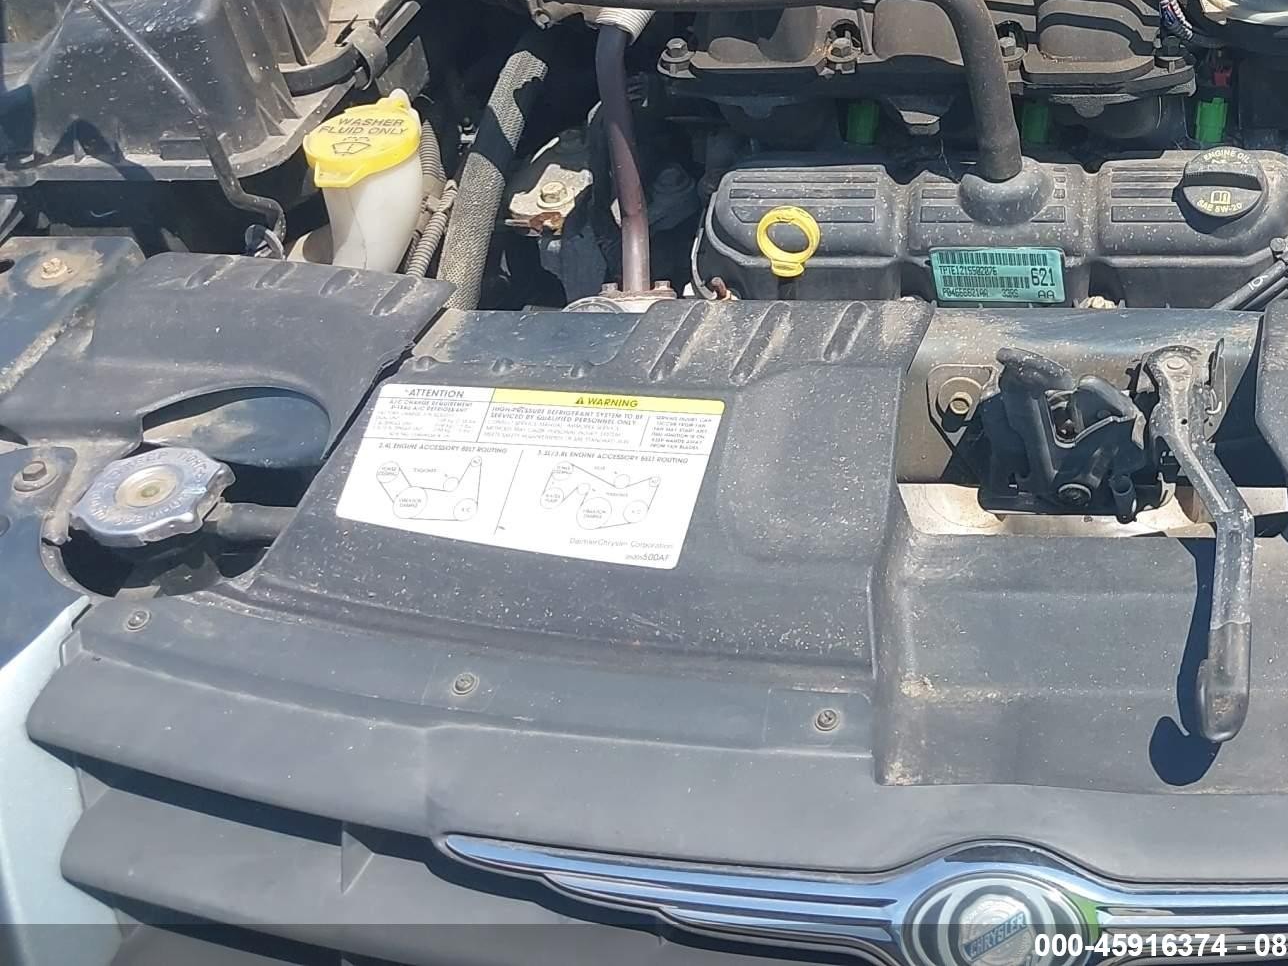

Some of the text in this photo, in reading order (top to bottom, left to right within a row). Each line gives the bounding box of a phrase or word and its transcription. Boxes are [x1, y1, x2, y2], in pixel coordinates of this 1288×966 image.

[339, 118, 405, 127] WASHER
[318, 125, 408, 135] FLUID ONLY
[1204, 150, 1250, 163] ENGINE OIL
[1197, 199, 1243, 212] SAE 5W-20
[1030, 268, 1055, 286] 621
[1038, 290, 1055, 298] AA
[409, 389, 465, 398] ATTENTION
[588, 397, 638, 407] WARNING
[630, 541, 673, 549] Corporation
[970, 913, 1026, 956] CHRYSLER
